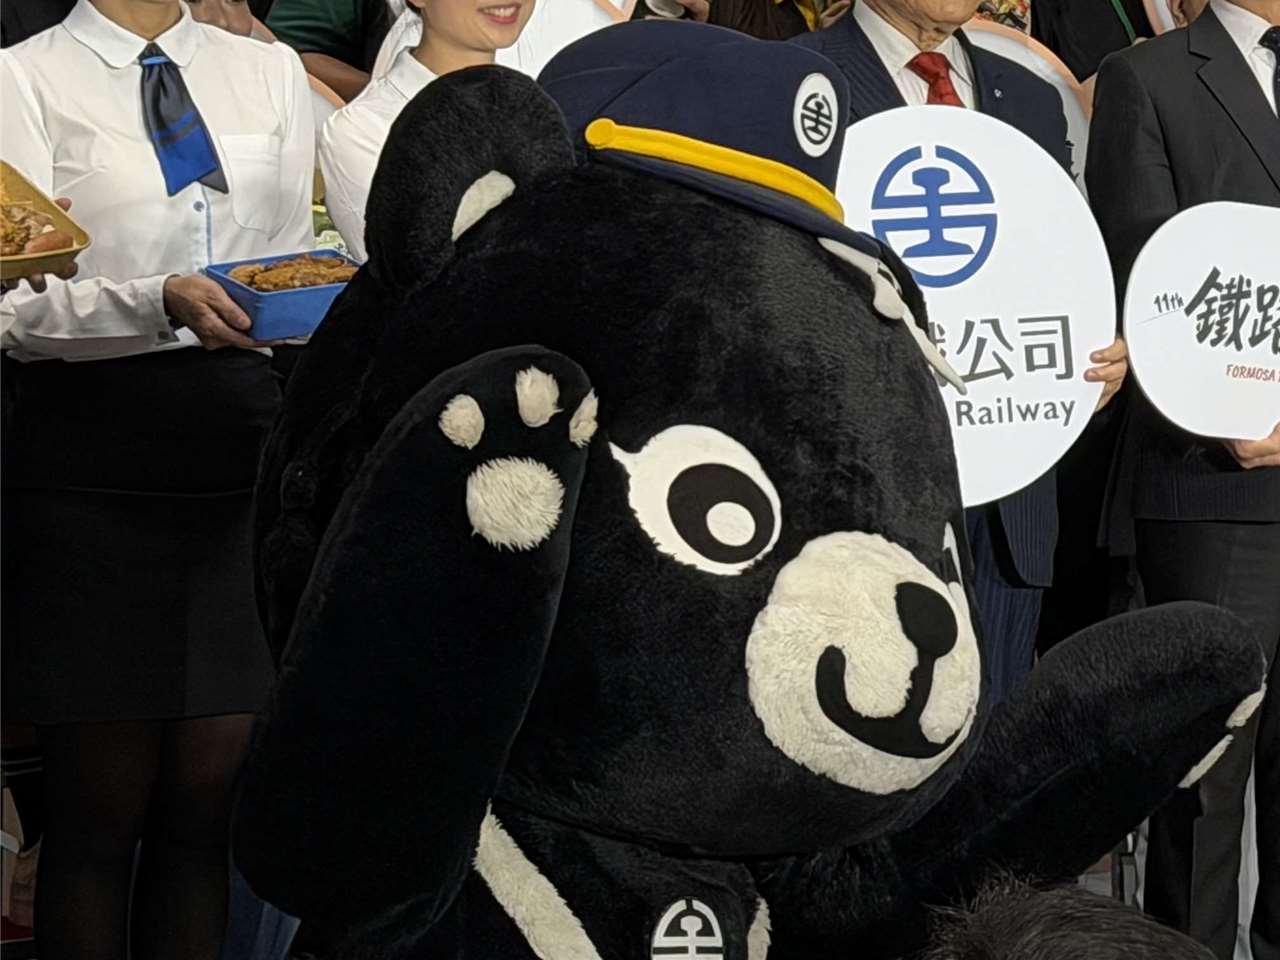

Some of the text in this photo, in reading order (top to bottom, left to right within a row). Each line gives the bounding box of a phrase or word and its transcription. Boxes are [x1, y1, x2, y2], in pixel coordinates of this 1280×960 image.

[1153, 291, 1184, 313] 11th
[1225, 364, 1276, 382] FORMOSA
[955, 397, 1076, 427] Railway
